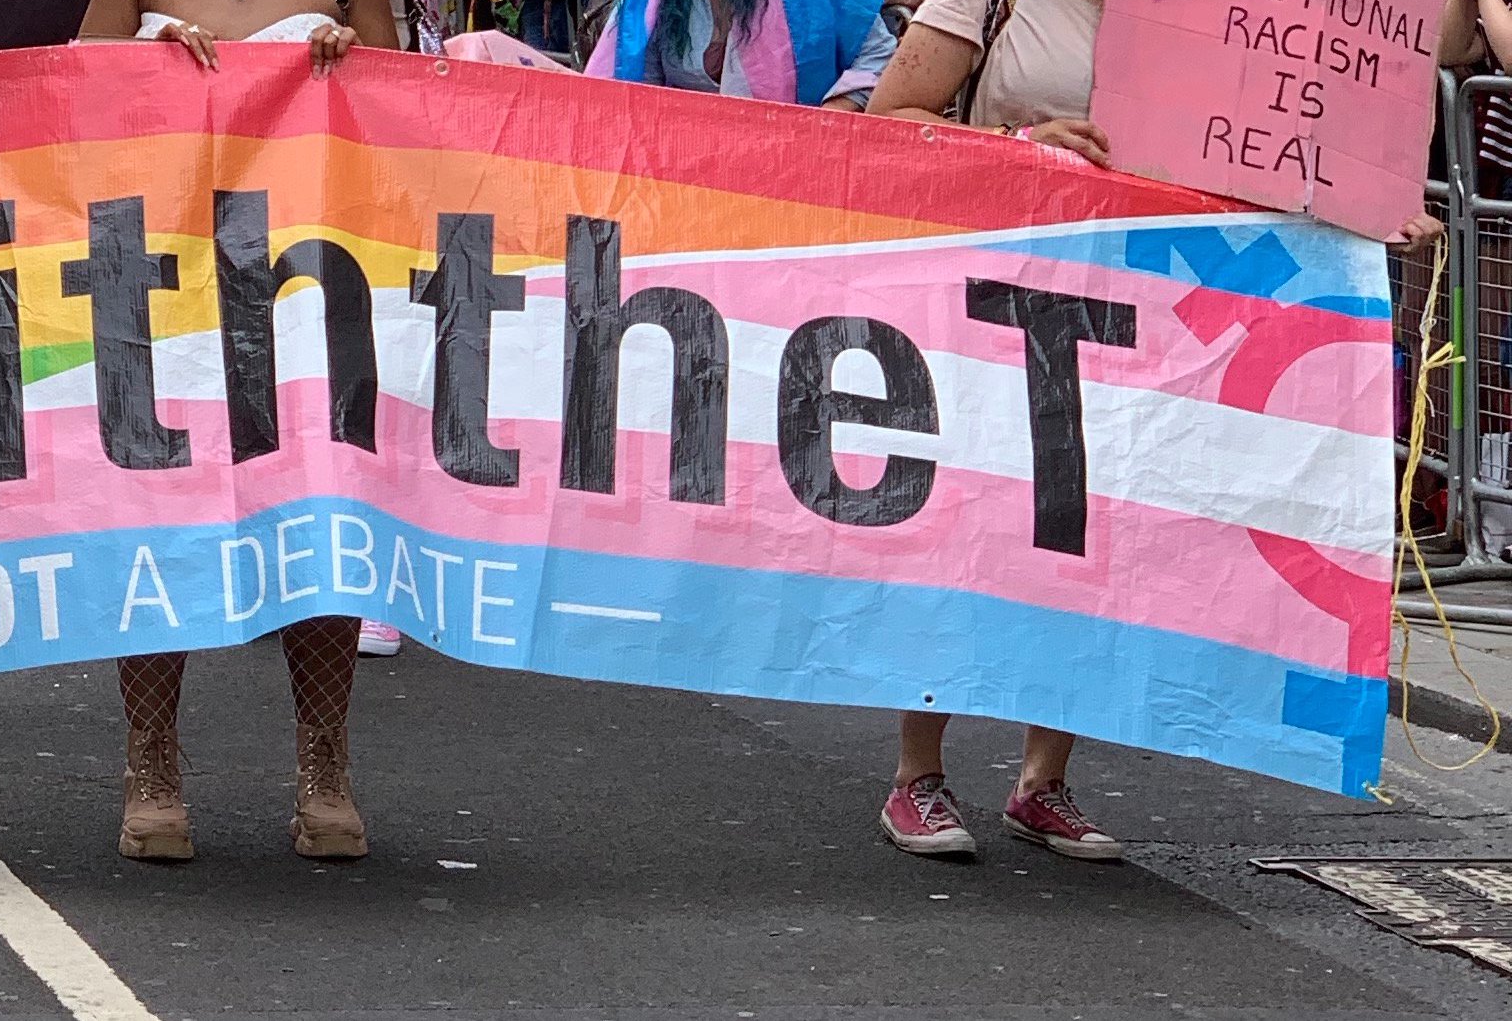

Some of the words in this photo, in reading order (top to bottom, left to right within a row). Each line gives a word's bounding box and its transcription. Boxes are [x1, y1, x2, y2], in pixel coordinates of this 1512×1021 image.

[1223, 6, 1381, 88] RACISM
[1267, 70, 1325, 120] IS
[1202, 116, 1334, 188] REAL
[118, 545, 180, 634] A
[220, 512, 519, 647] DEBATE
